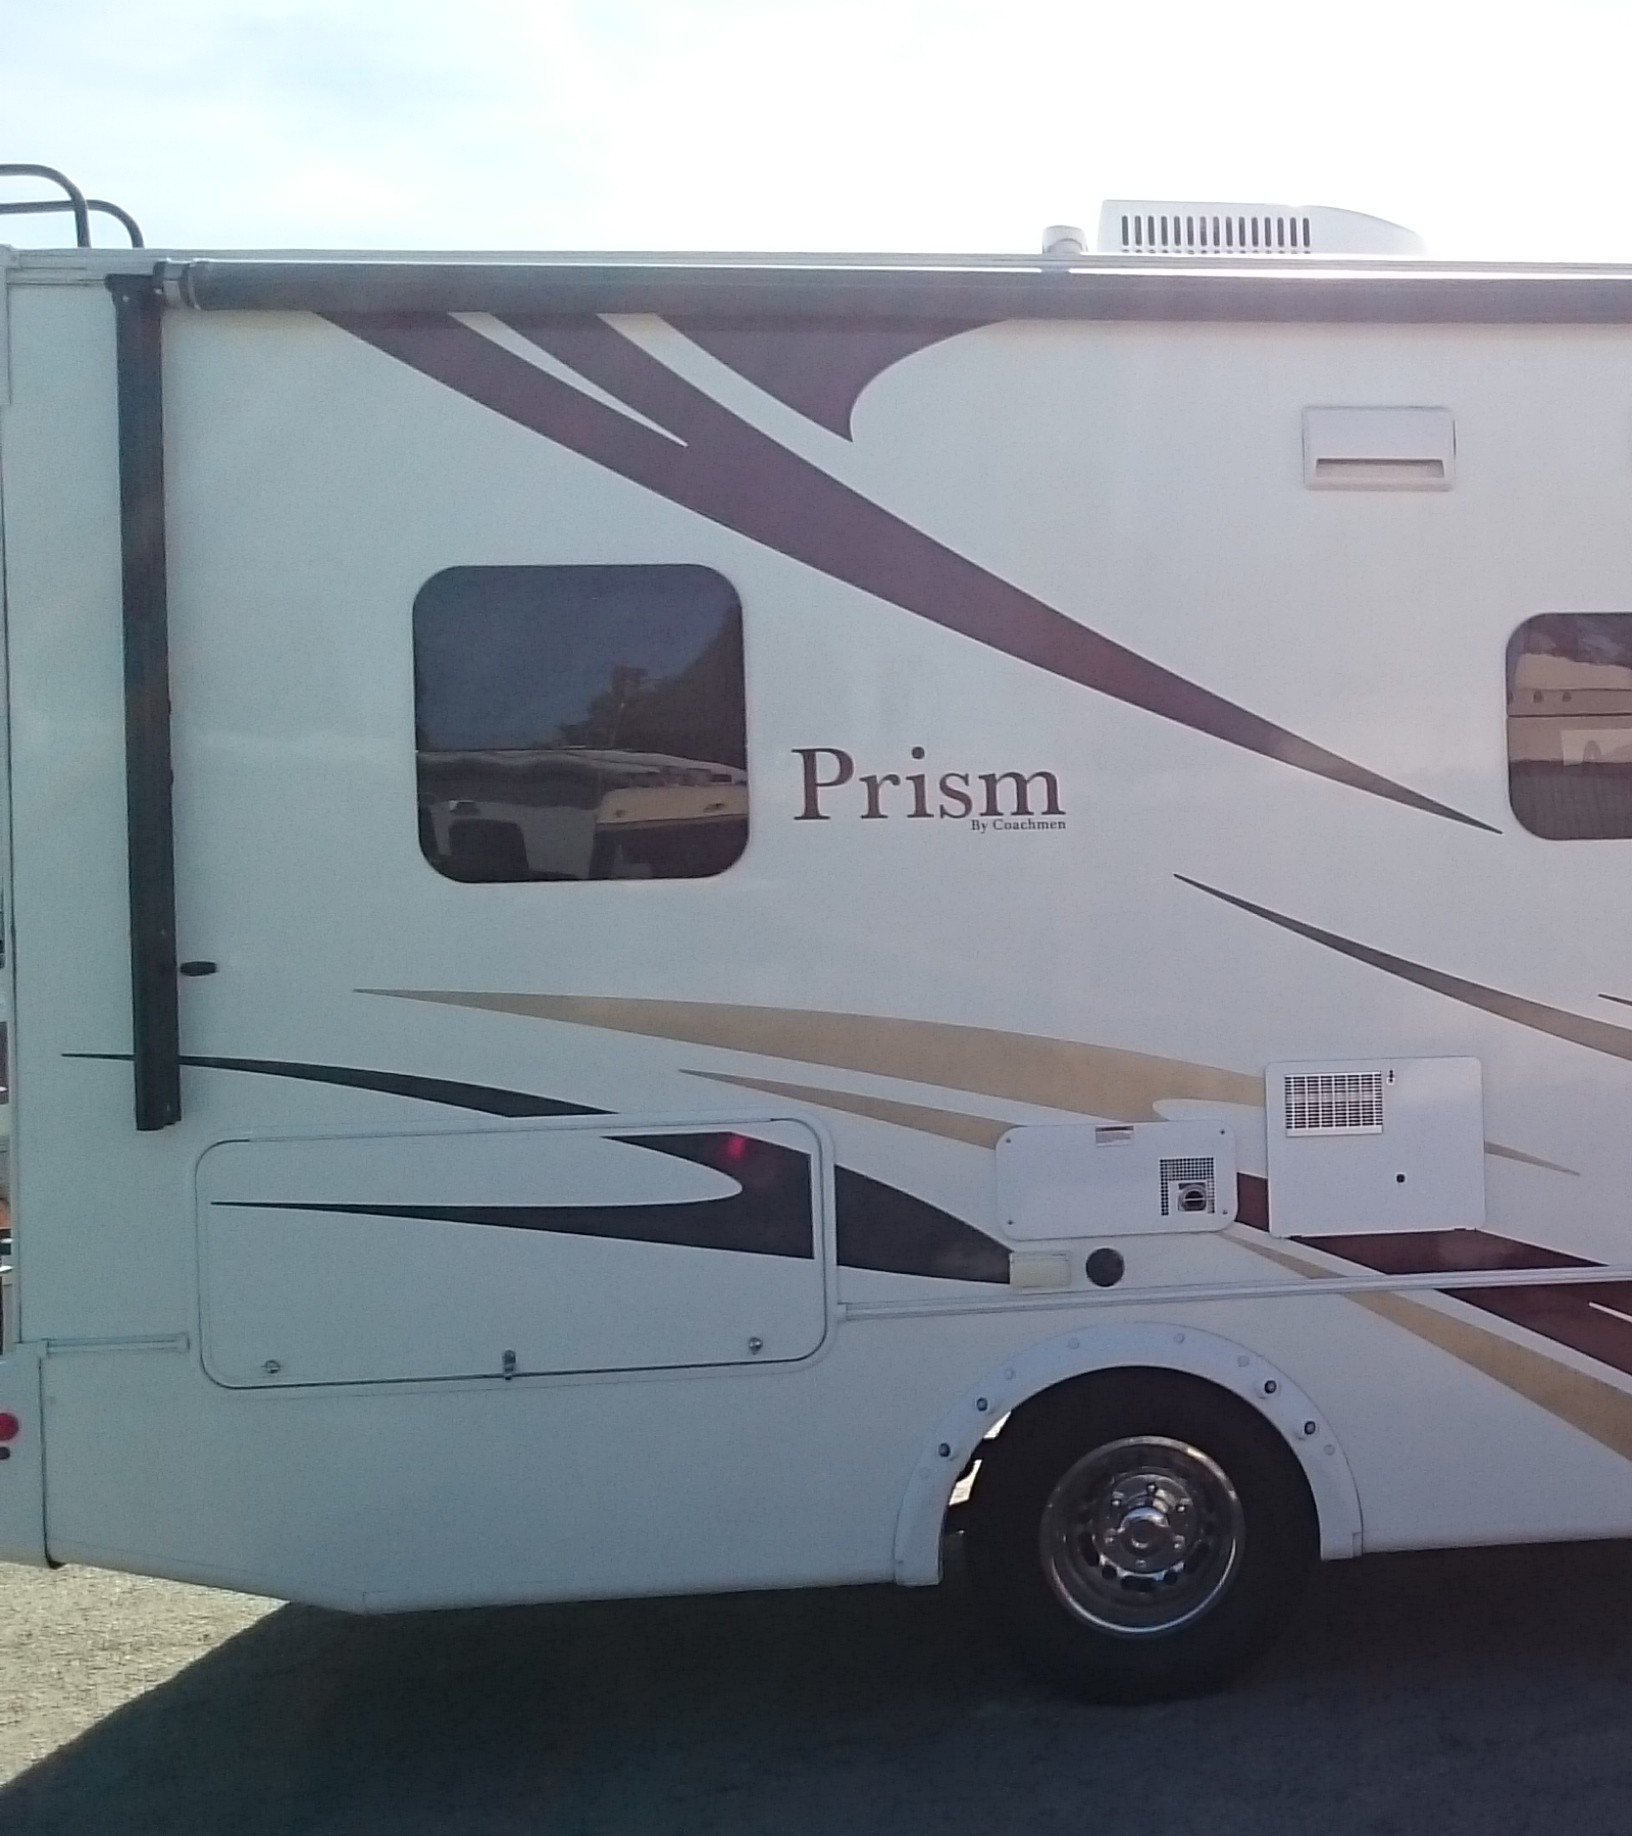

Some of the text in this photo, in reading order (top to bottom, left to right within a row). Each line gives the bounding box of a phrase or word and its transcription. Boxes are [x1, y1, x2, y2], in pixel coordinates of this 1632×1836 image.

[791, 746, 1067, 820] Prism
[971, 818, 1067, 833] By Coachmen
